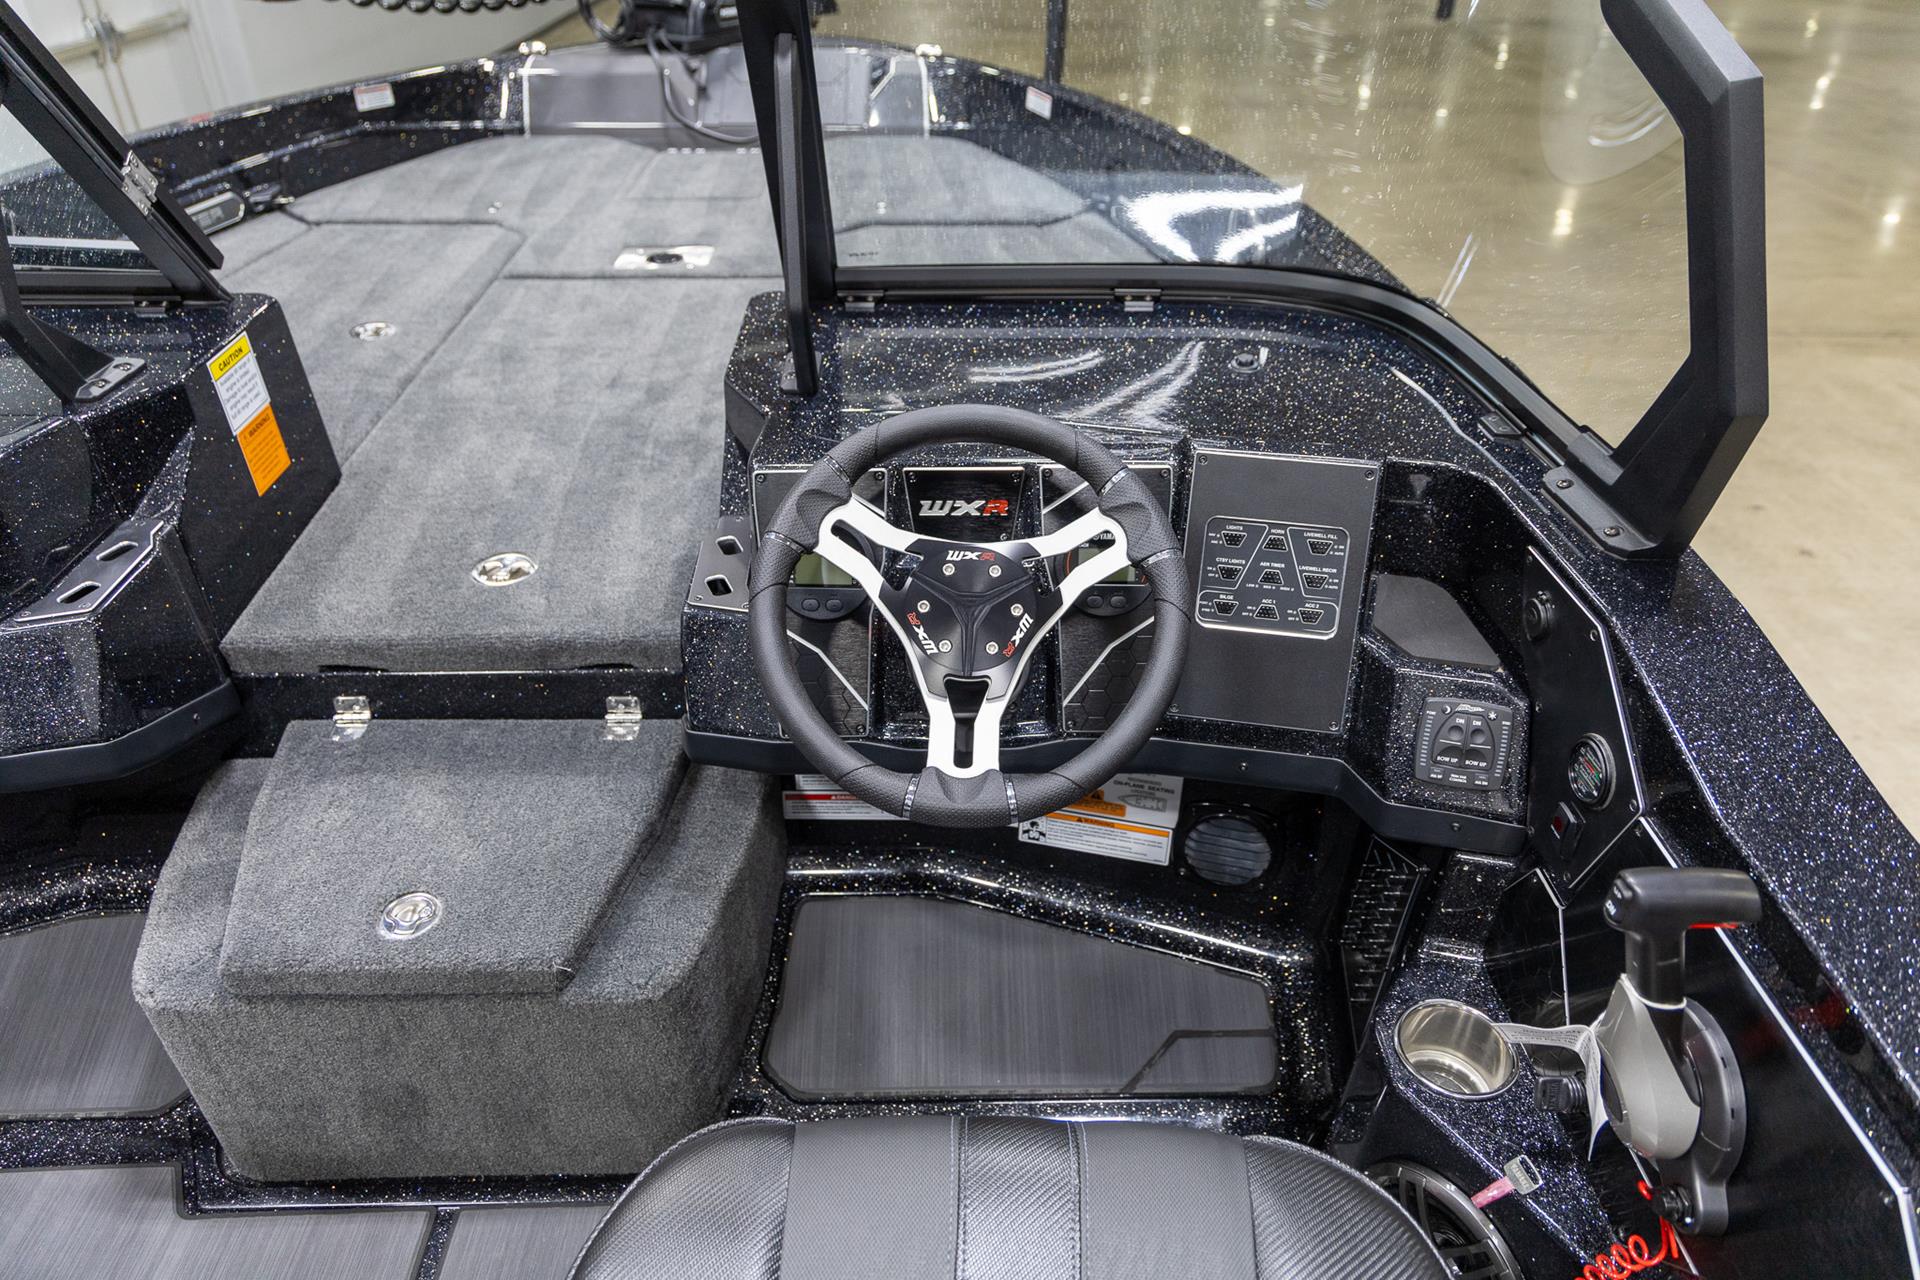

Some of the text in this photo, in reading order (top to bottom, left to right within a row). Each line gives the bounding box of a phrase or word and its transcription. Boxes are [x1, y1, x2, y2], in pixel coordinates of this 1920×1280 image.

[218, 346, 243, 371] CAUTION
[919, 500, 1009, 516] WXR
[946, 550, 995, 561] WXR
